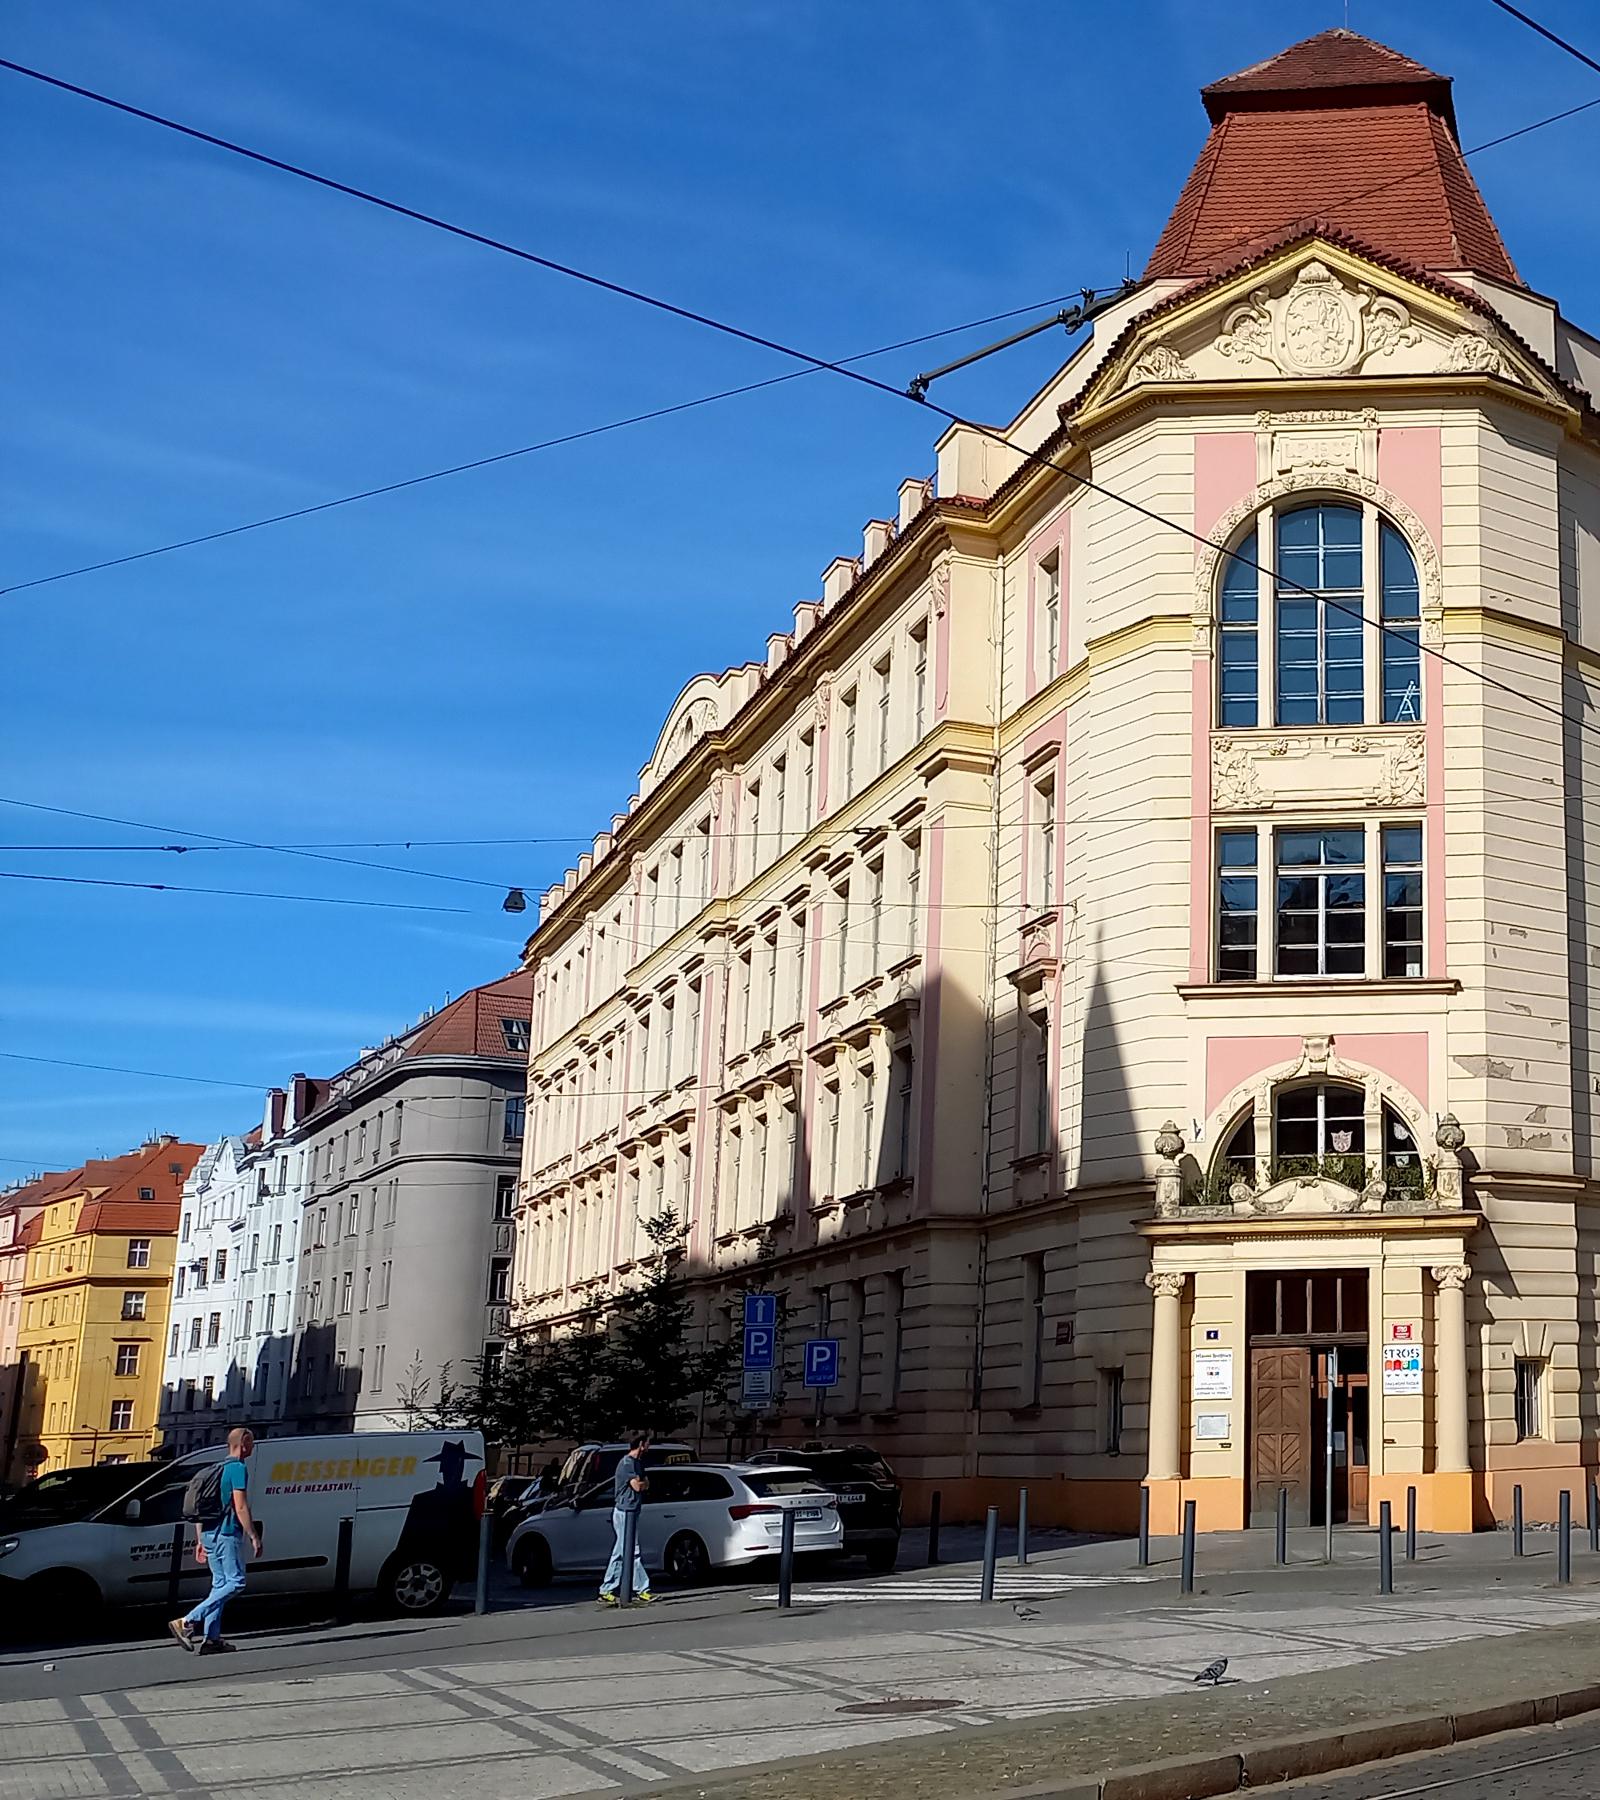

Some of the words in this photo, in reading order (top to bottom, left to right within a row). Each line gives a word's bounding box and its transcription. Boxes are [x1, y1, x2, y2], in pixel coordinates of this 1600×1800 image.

[750, 1331, 768, 1355] P
[811, 1346, 831, 1372] P
[271, 1456, 418, 1482] MESSENGER
[265, 1486, 281, 1495] NIC
